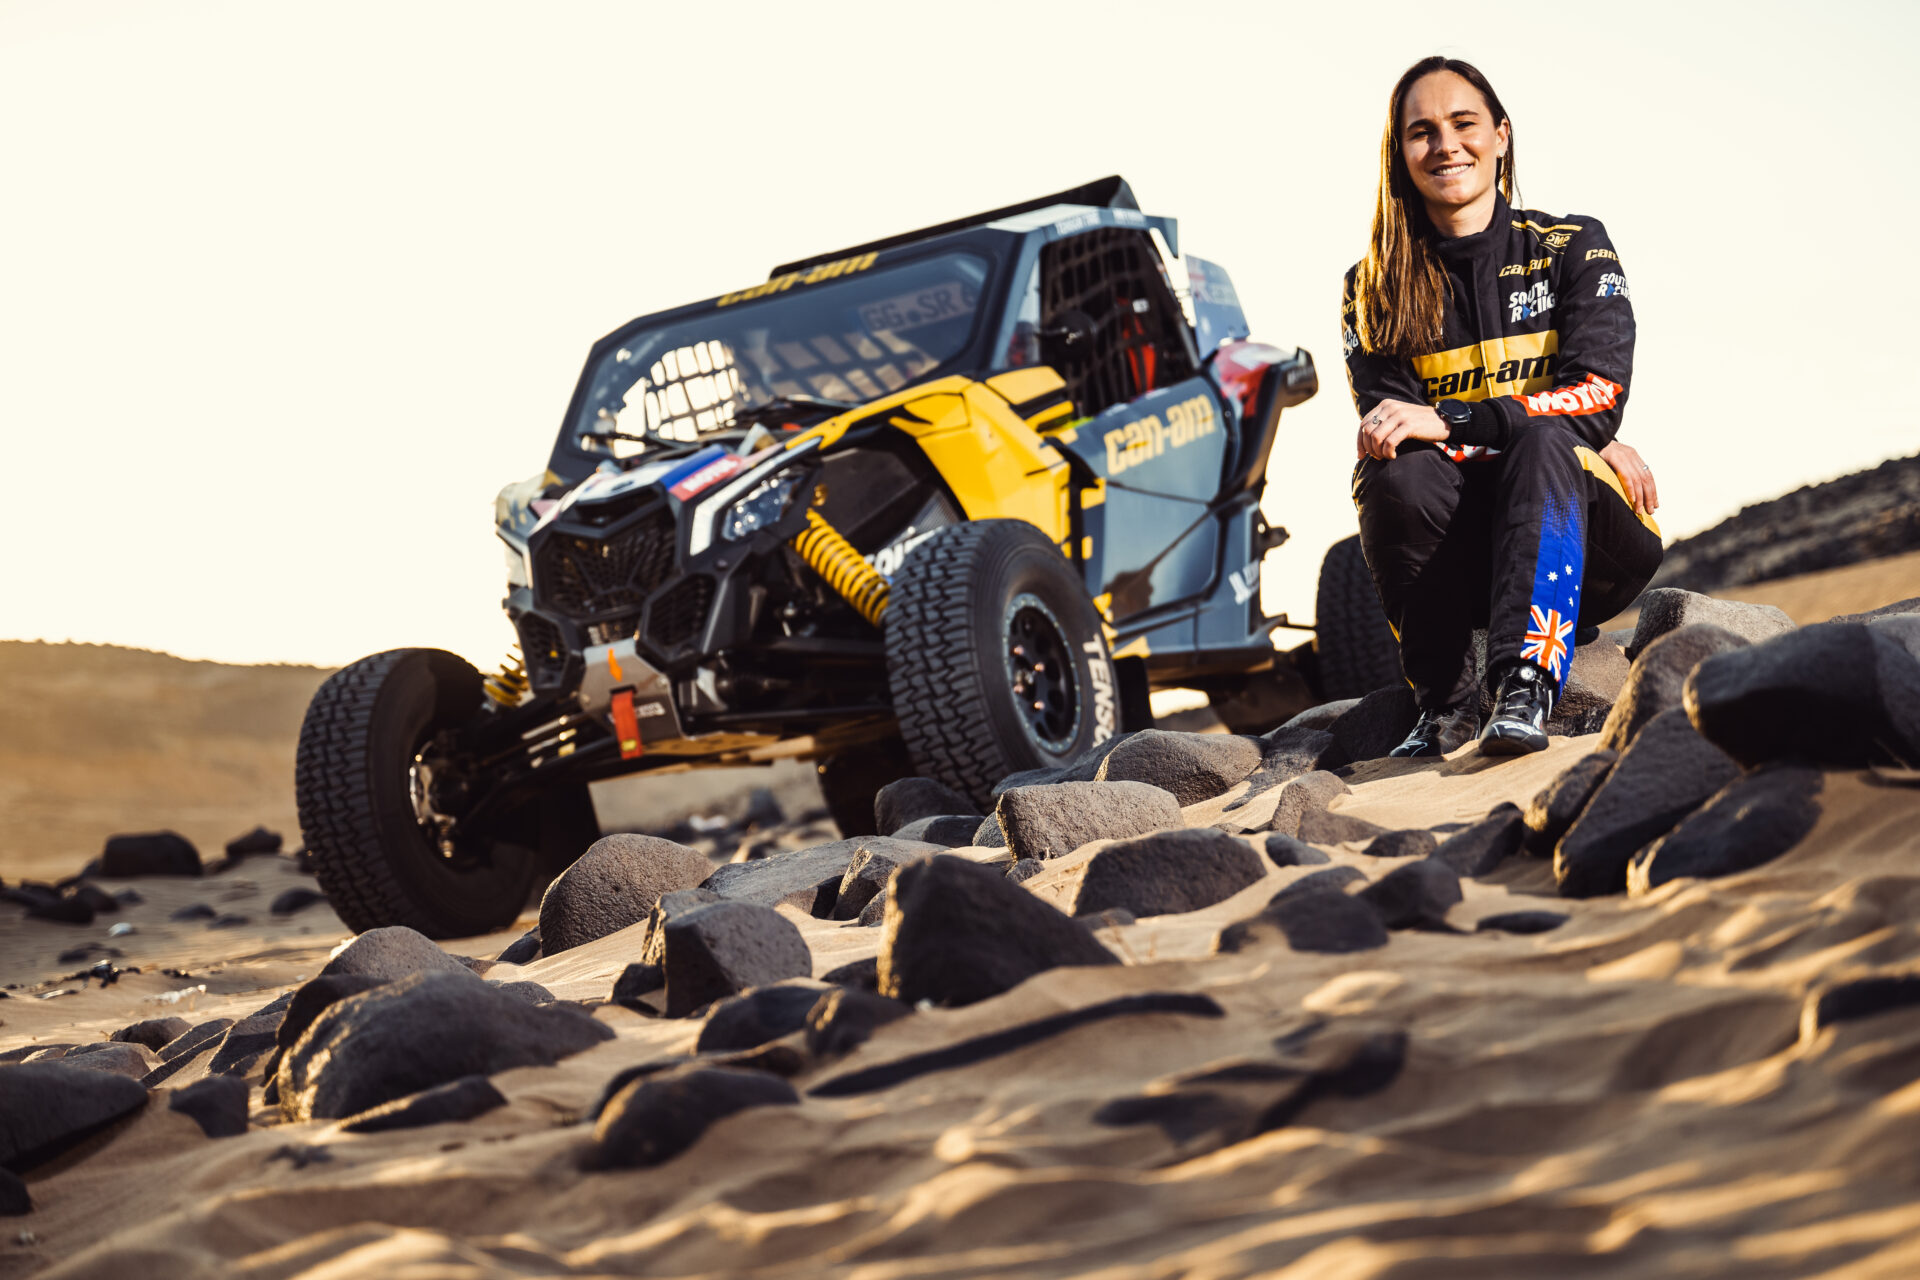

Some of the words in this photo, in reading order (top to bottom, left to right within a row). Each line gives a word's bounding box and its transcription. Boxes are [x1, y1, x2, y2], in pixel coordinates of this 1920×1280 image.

[1545, 234, 1571, 245] OMP
[1498, 256, 1553, 278] canam
[1508, 279, 1549, 309] SOUTH
[1422, 353, 1558, 399] can-am
[1104, 394, 1216, 475] can-am
